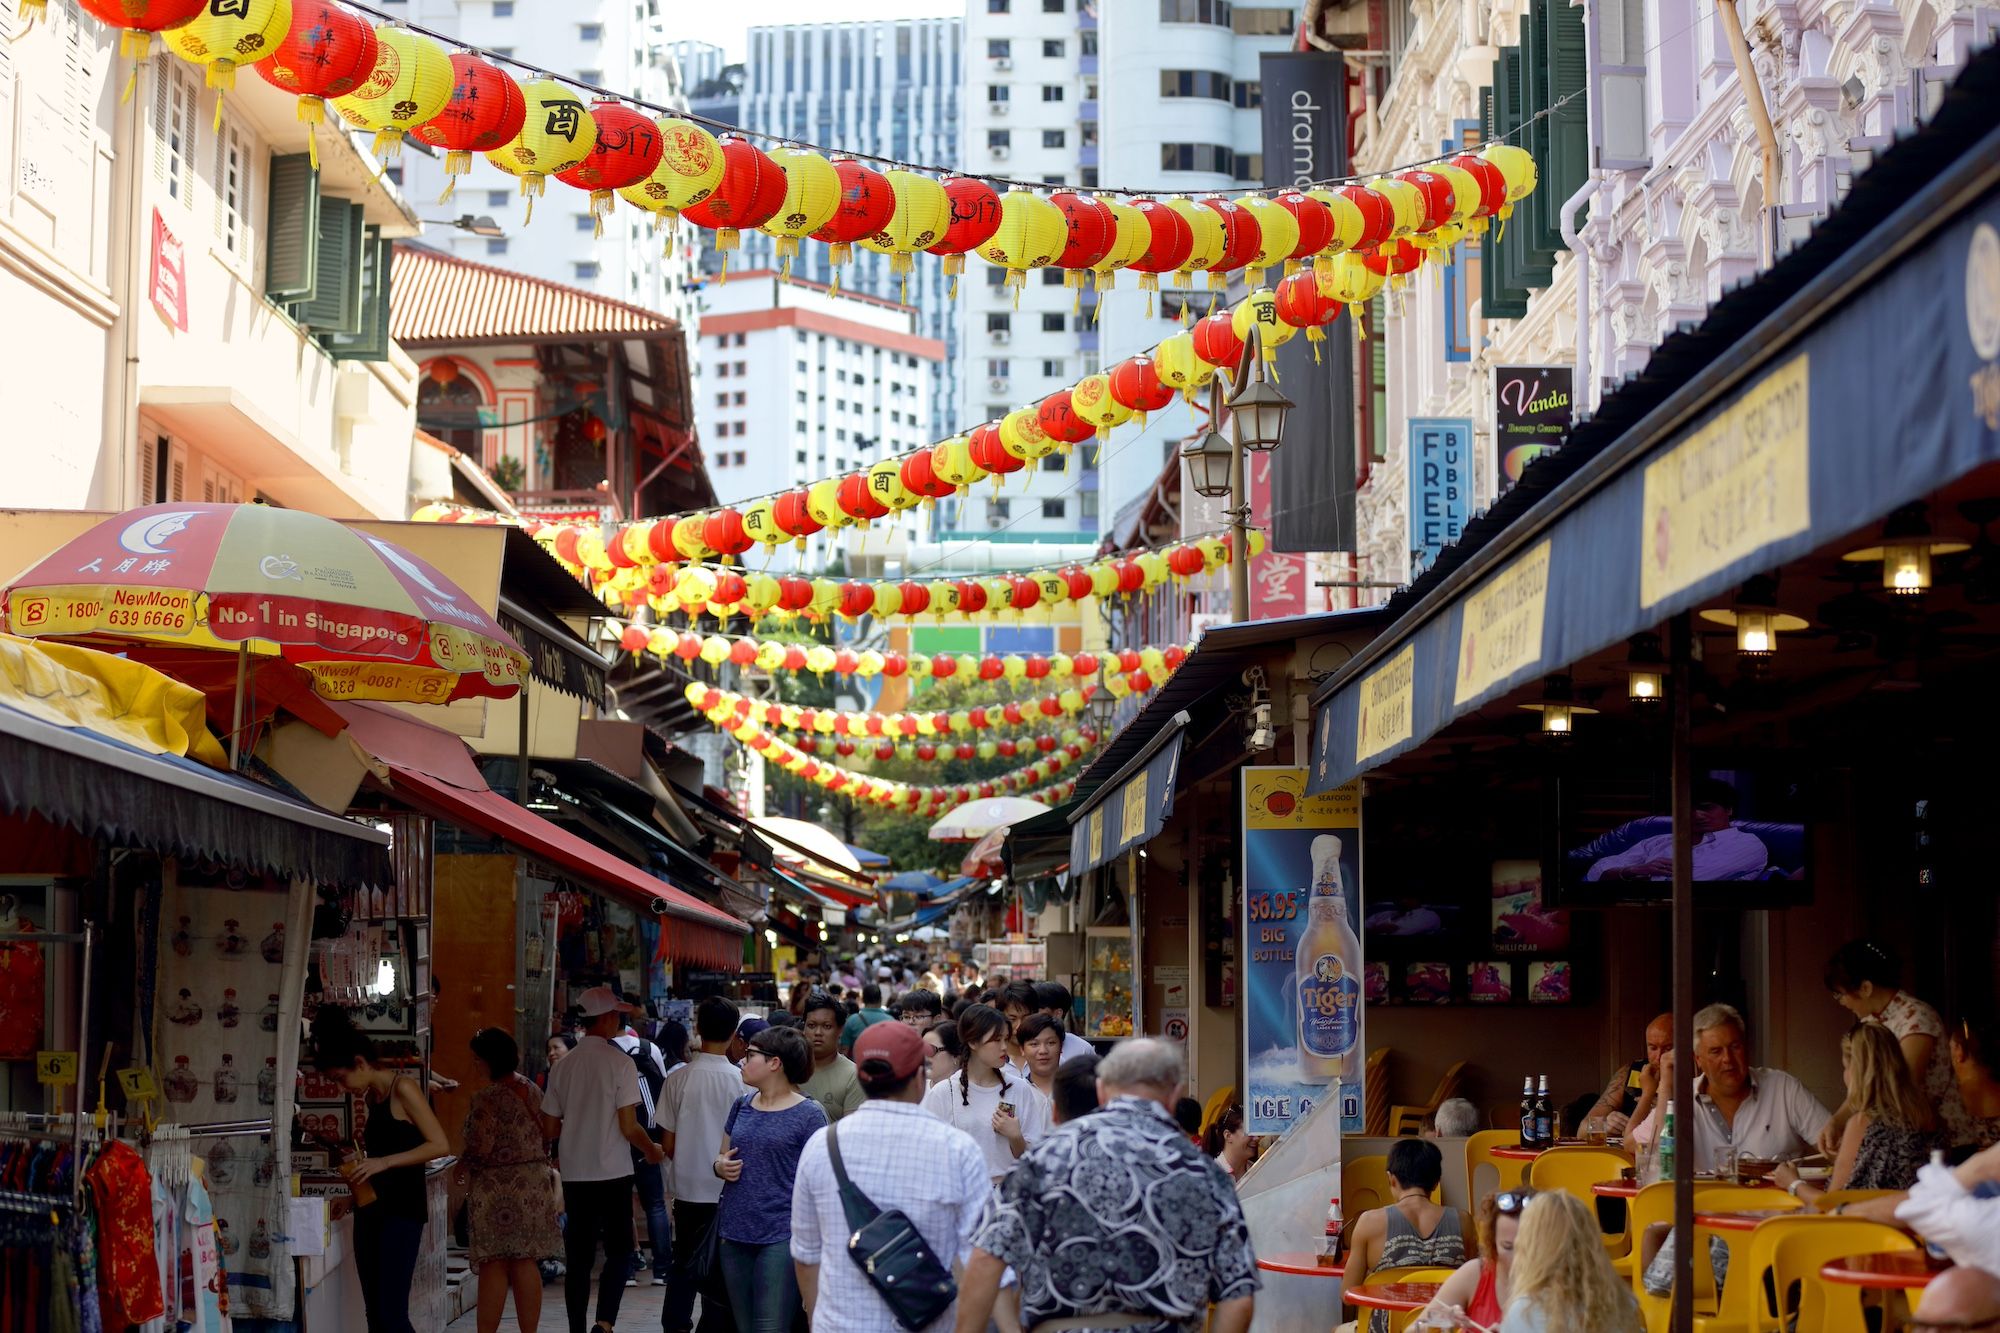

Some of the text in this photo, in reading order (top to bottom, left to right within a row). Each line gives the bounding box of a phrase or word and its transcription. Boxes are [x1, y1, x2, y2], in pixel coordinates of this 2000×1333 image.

[540, 99, 586, 143] 酉
[1500, 378, 1569, 416] Vanda
[1423, 432, 1441, 547] FREE
[1445, 432, 1458, 537] BUBBLE
[1257, 555, 1300, 603] 堂
[67, 600, 104, 618] 1800-
[114, 589, 189, 609] NewMoon
[109, 609, 185, 629] 639 6666
[218, 606, 255, 624] No.
[278, 609, 298, 627] in
[304, 611, 409, 646] Singapore
[1250, 892, 1298, 921] $6.95
[1261, 927, 1285, 943] BIG
[1253, 949, 1294, 961] BOTTLE
[1303, 985, 1357, 1017] Tiger
[1254, 1096, 1358, 1119] ICE CD
